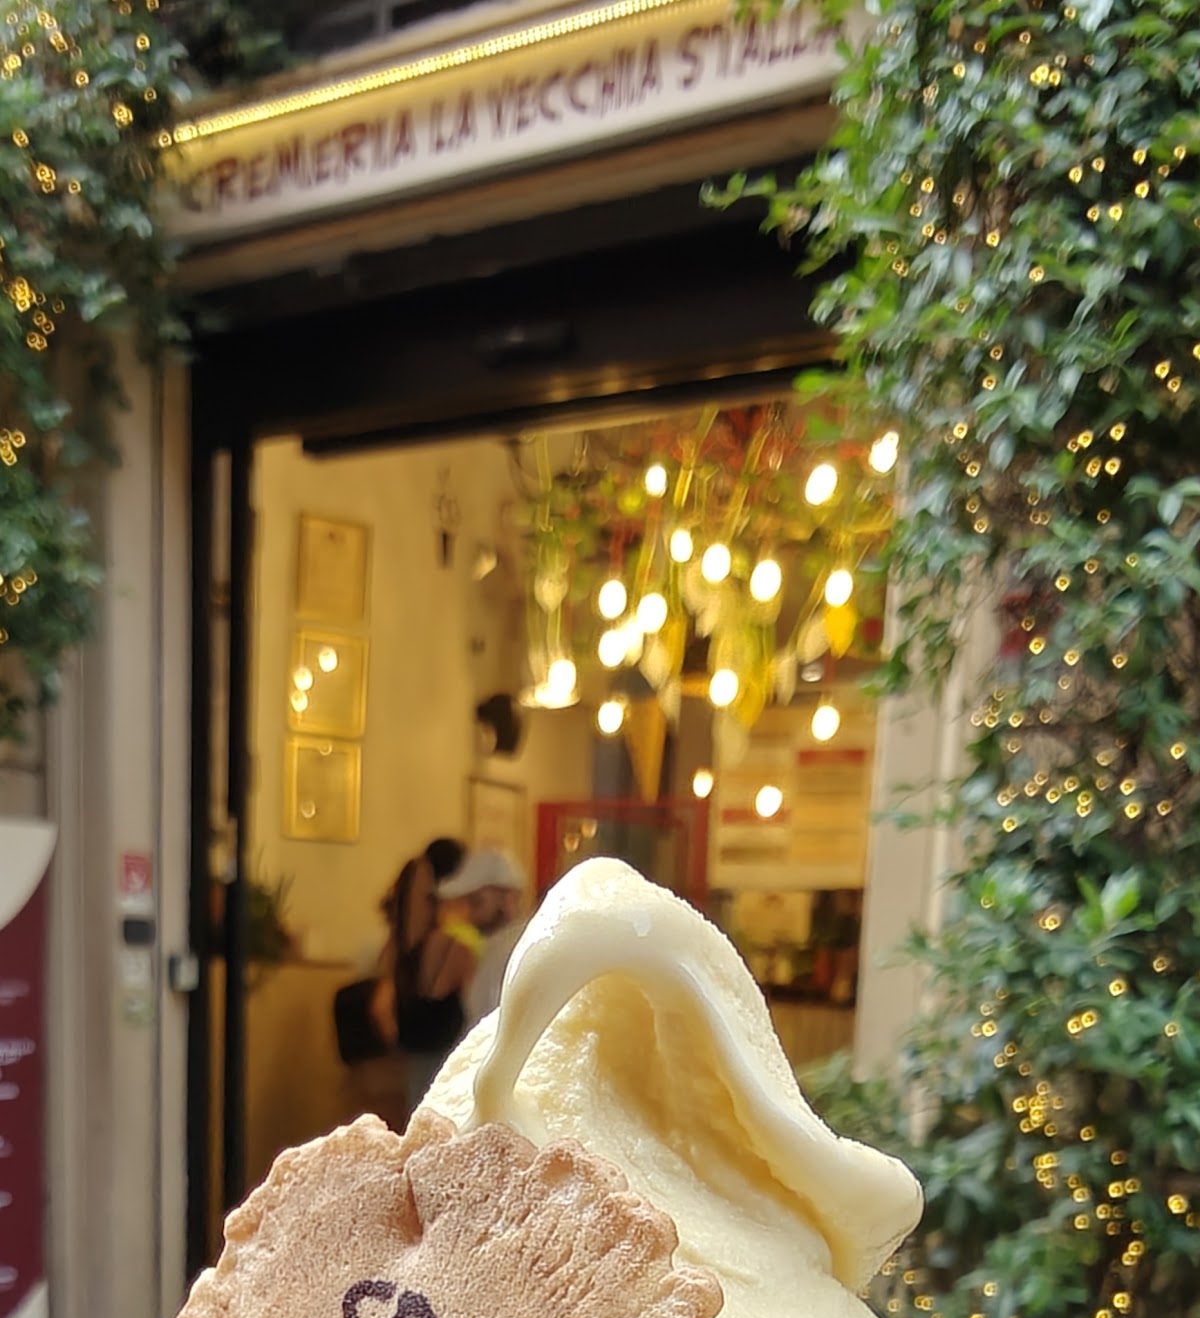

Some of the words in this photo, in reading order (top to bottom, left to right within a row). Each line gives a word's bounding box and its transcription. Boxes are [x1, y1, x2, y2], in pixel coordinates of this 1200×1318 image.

[178, 107, 415, 214] CREMERIA
[429, 88, 478, 153] LA
[485, 39, 662, 140] VECCHIA
